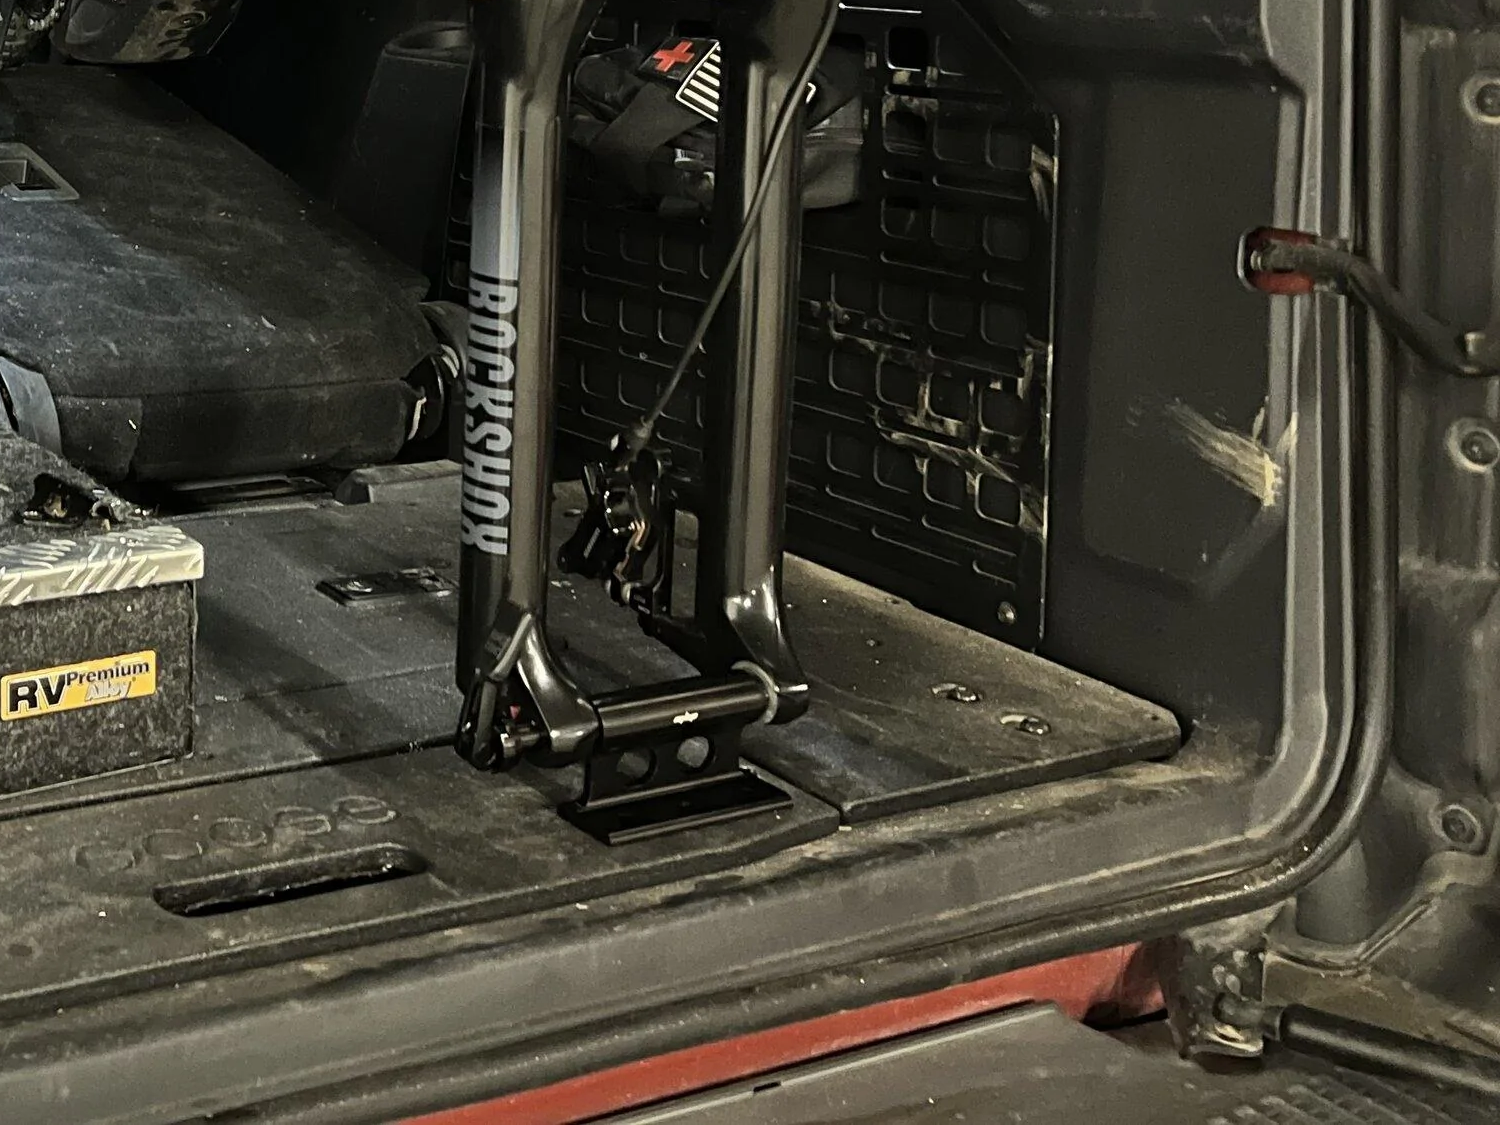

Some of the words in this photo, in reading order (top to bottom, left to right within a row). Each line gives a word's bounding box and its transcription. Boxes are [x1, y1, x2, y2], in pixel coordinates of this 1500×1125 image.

[461, 277, 518, 555] ROCKSHOX
[8, 674, 67, 713] RV
[66, 660, 150, 686] Premium
[84, 680, 132, 701] Alloy
